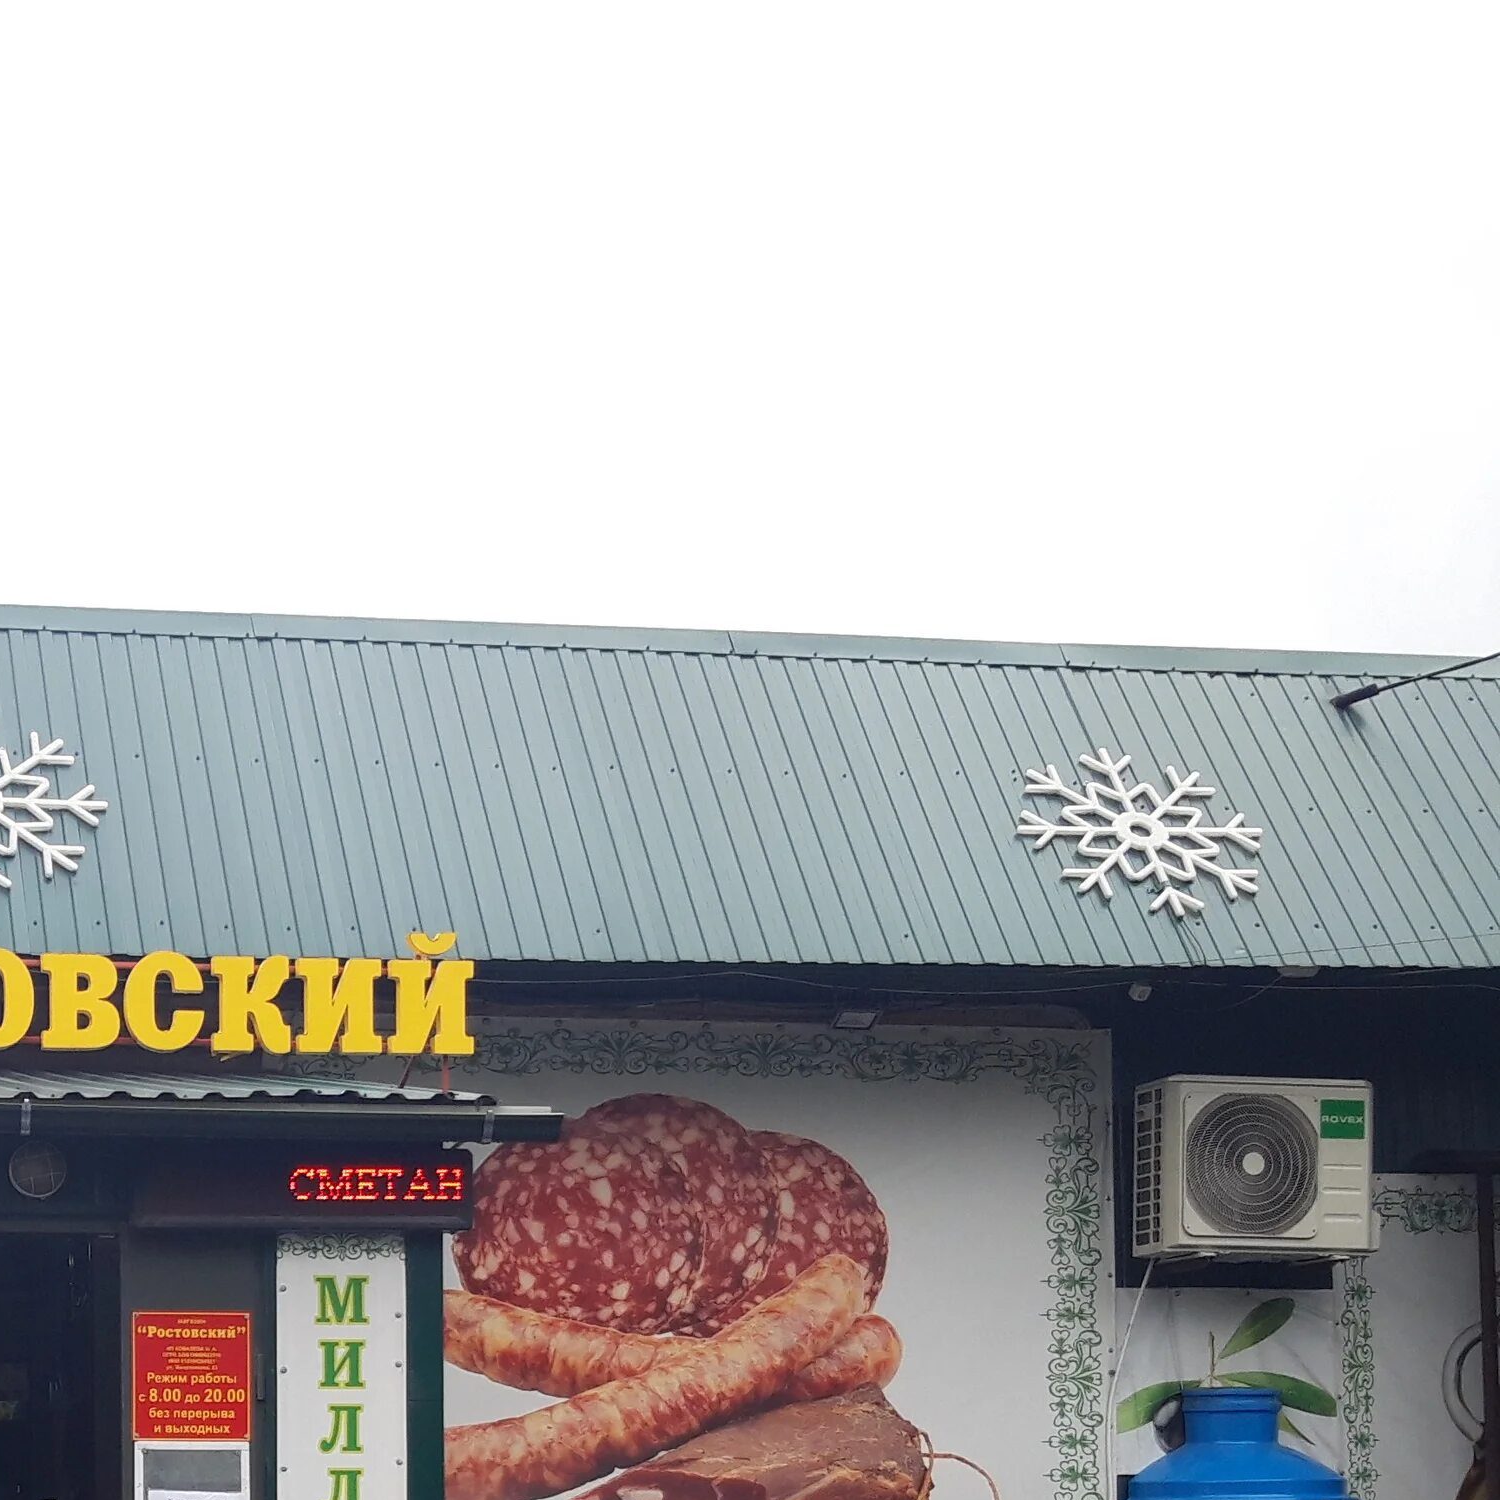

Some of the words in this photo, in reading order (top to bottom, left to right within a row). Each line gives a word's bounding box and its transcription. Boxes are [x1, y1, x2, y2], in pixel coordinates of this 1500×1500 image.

[1321, 1114, 1364, 1124] ROVEX
[288, 1167, 465, 1201] СМЕТАН
[146, 1372, 187, 1383] Режим
[190, 1372, 237, 1386] работы
[138, 1394, 147, 1402] с
[149, 1388, 181, 1402] 8.00
[184, 1394, 201, 1404] до
[203, 1388, 246, 1403] 20.00
[148, 1407, 170, 1418] без
[173, 1409, 235, 1420] перерыва
[153, 1424, 161, 1433] и
[165, 1424, 231, 1435] выходных
